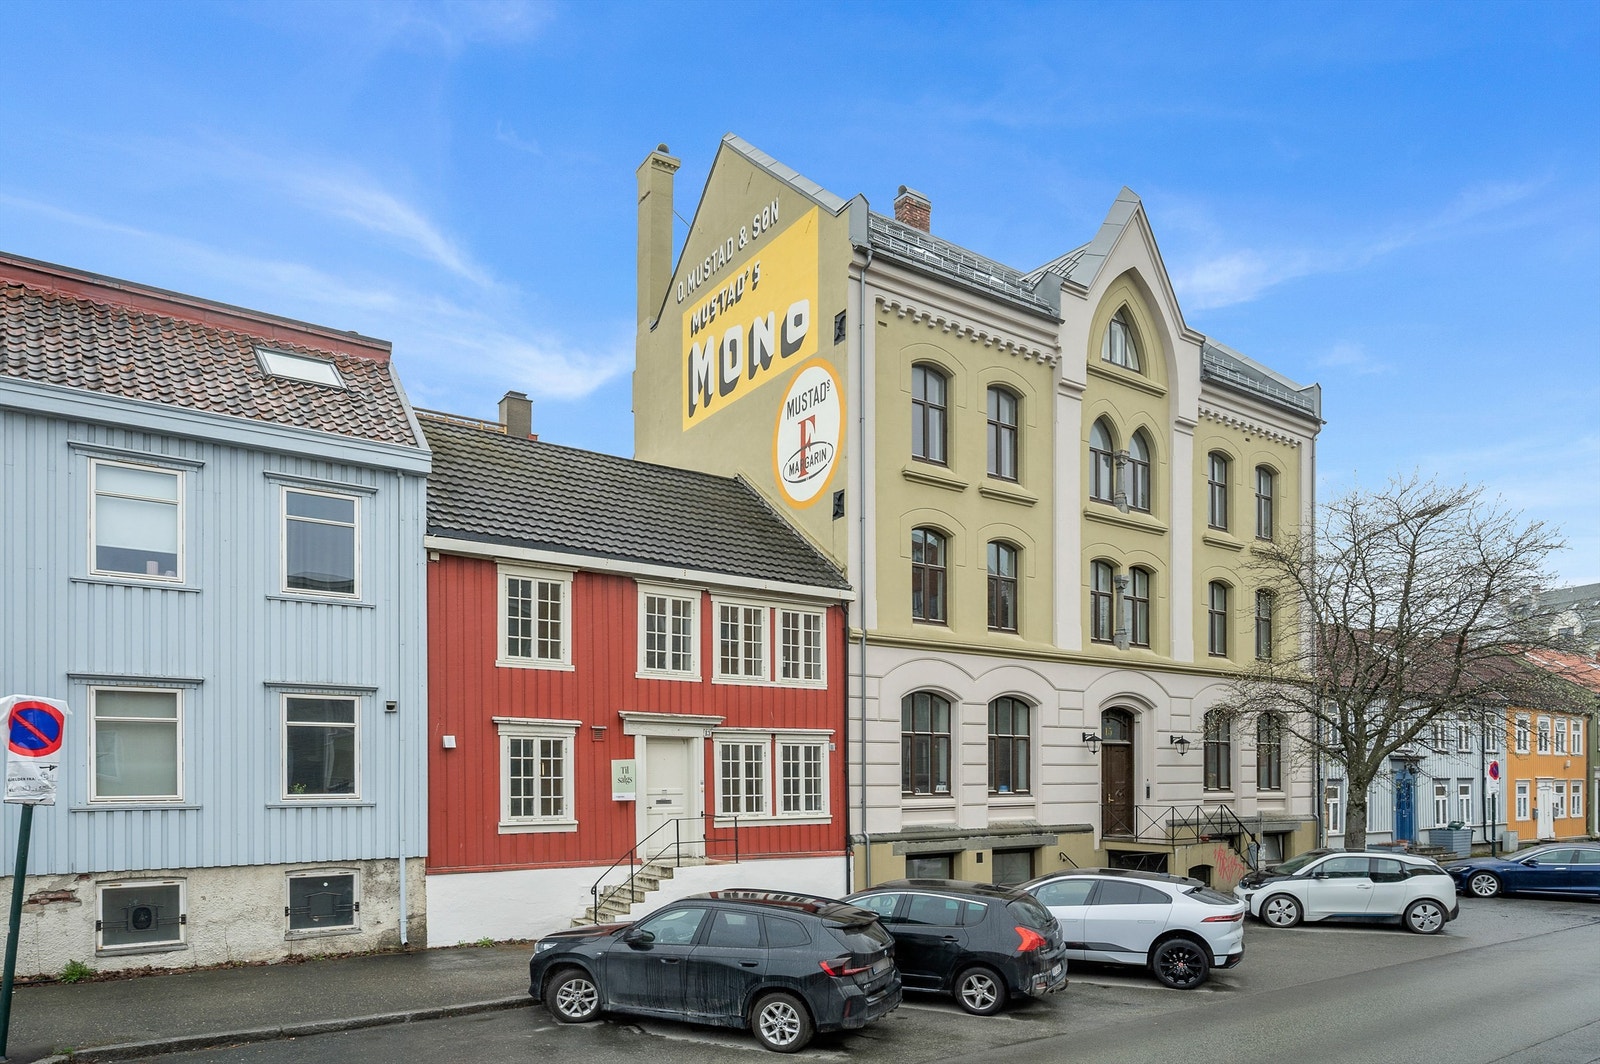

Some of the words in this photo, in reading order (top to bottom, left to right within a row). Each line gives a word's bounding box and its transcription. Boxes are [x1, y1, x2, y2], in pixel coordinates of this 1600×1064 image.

[687, 236, 734, 296] MUSTAD
[738, 226, 749, 251] &
[752, 197, 779, 240] SØN
[688, 298, 810, 417] MONO
[788, 447, 827, 476] MARGARIN
[797, 414, 816, 479] F
[620, 765, 630, 775] Til
